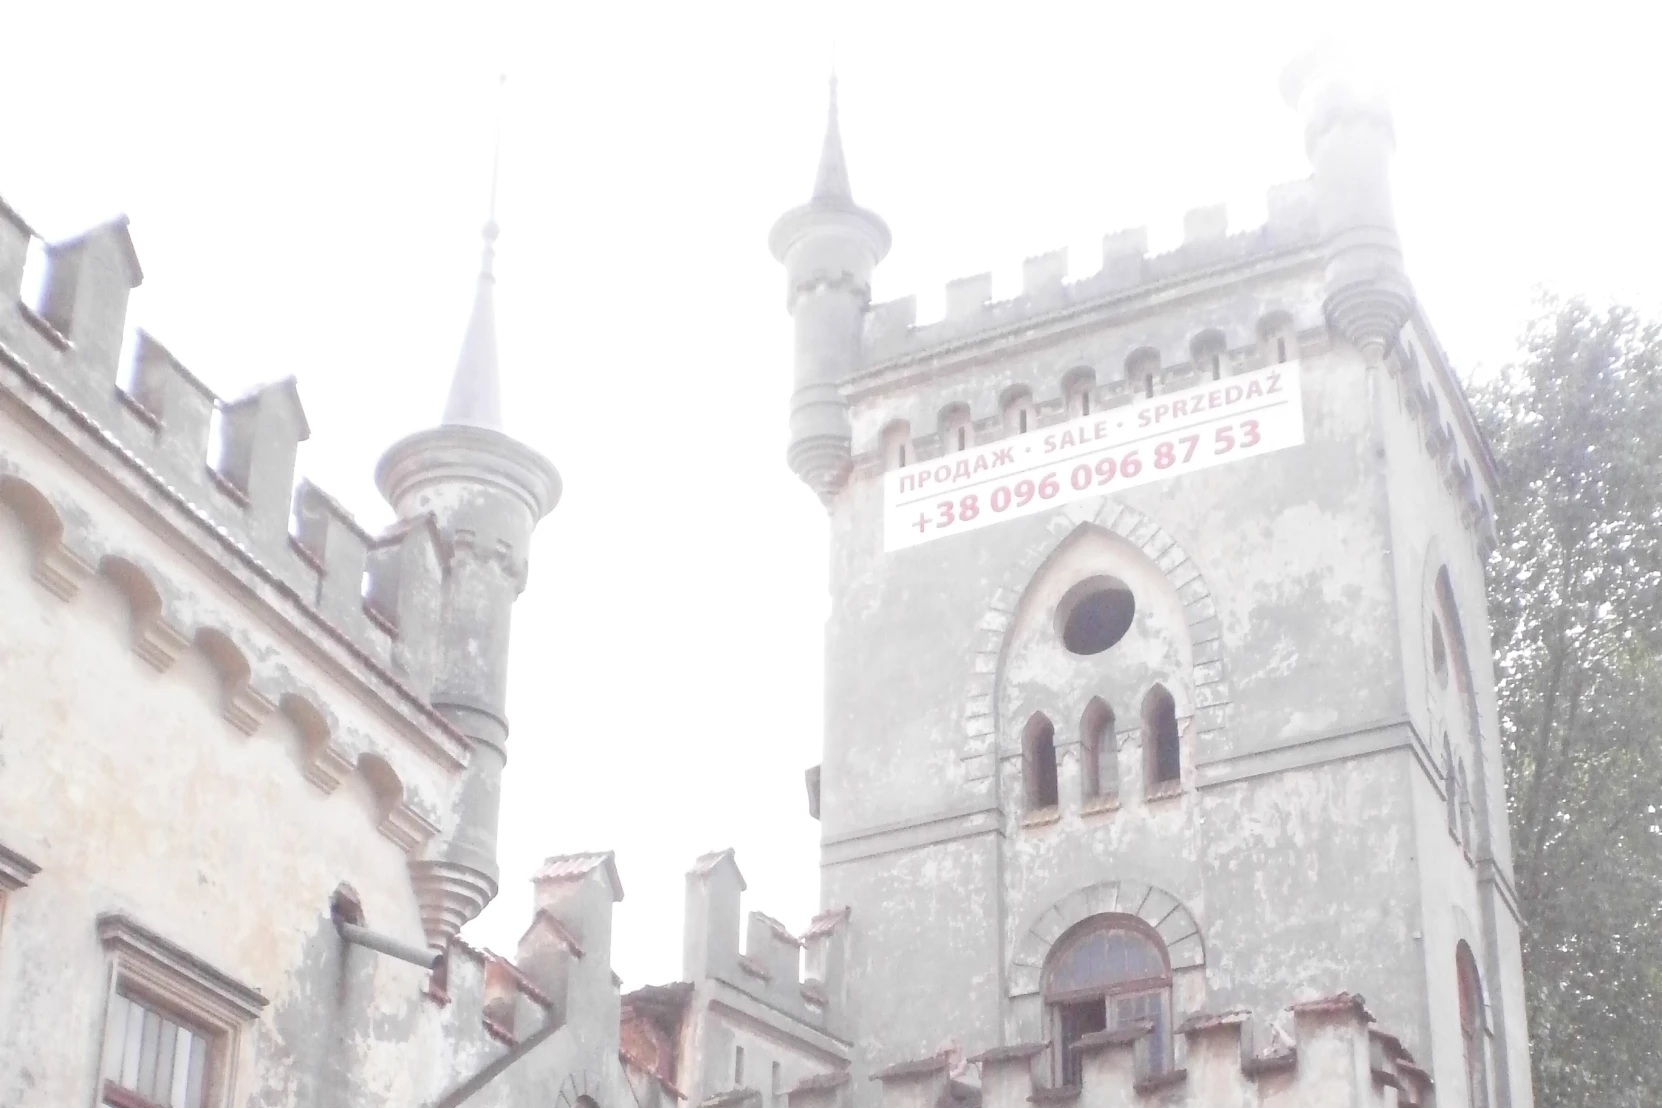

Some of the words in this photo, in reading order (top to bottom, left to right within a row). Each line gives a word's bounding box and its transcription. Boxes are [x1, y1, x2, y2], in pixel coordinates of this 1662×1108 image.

[900, 446, 1015, 493] ПРОДАЖ
[1043, 420, 1107, 454] SALE
[1138, 370, 1283, 428] SPRZEDAŻ
[912, 494, 980, 533] +38
[990, 471, 1060, 513] 096
[1070, 449, 1143, 491] 096
[1153, 434, 1200, 469] 87
[1214, 420, 1261, 455] 53
